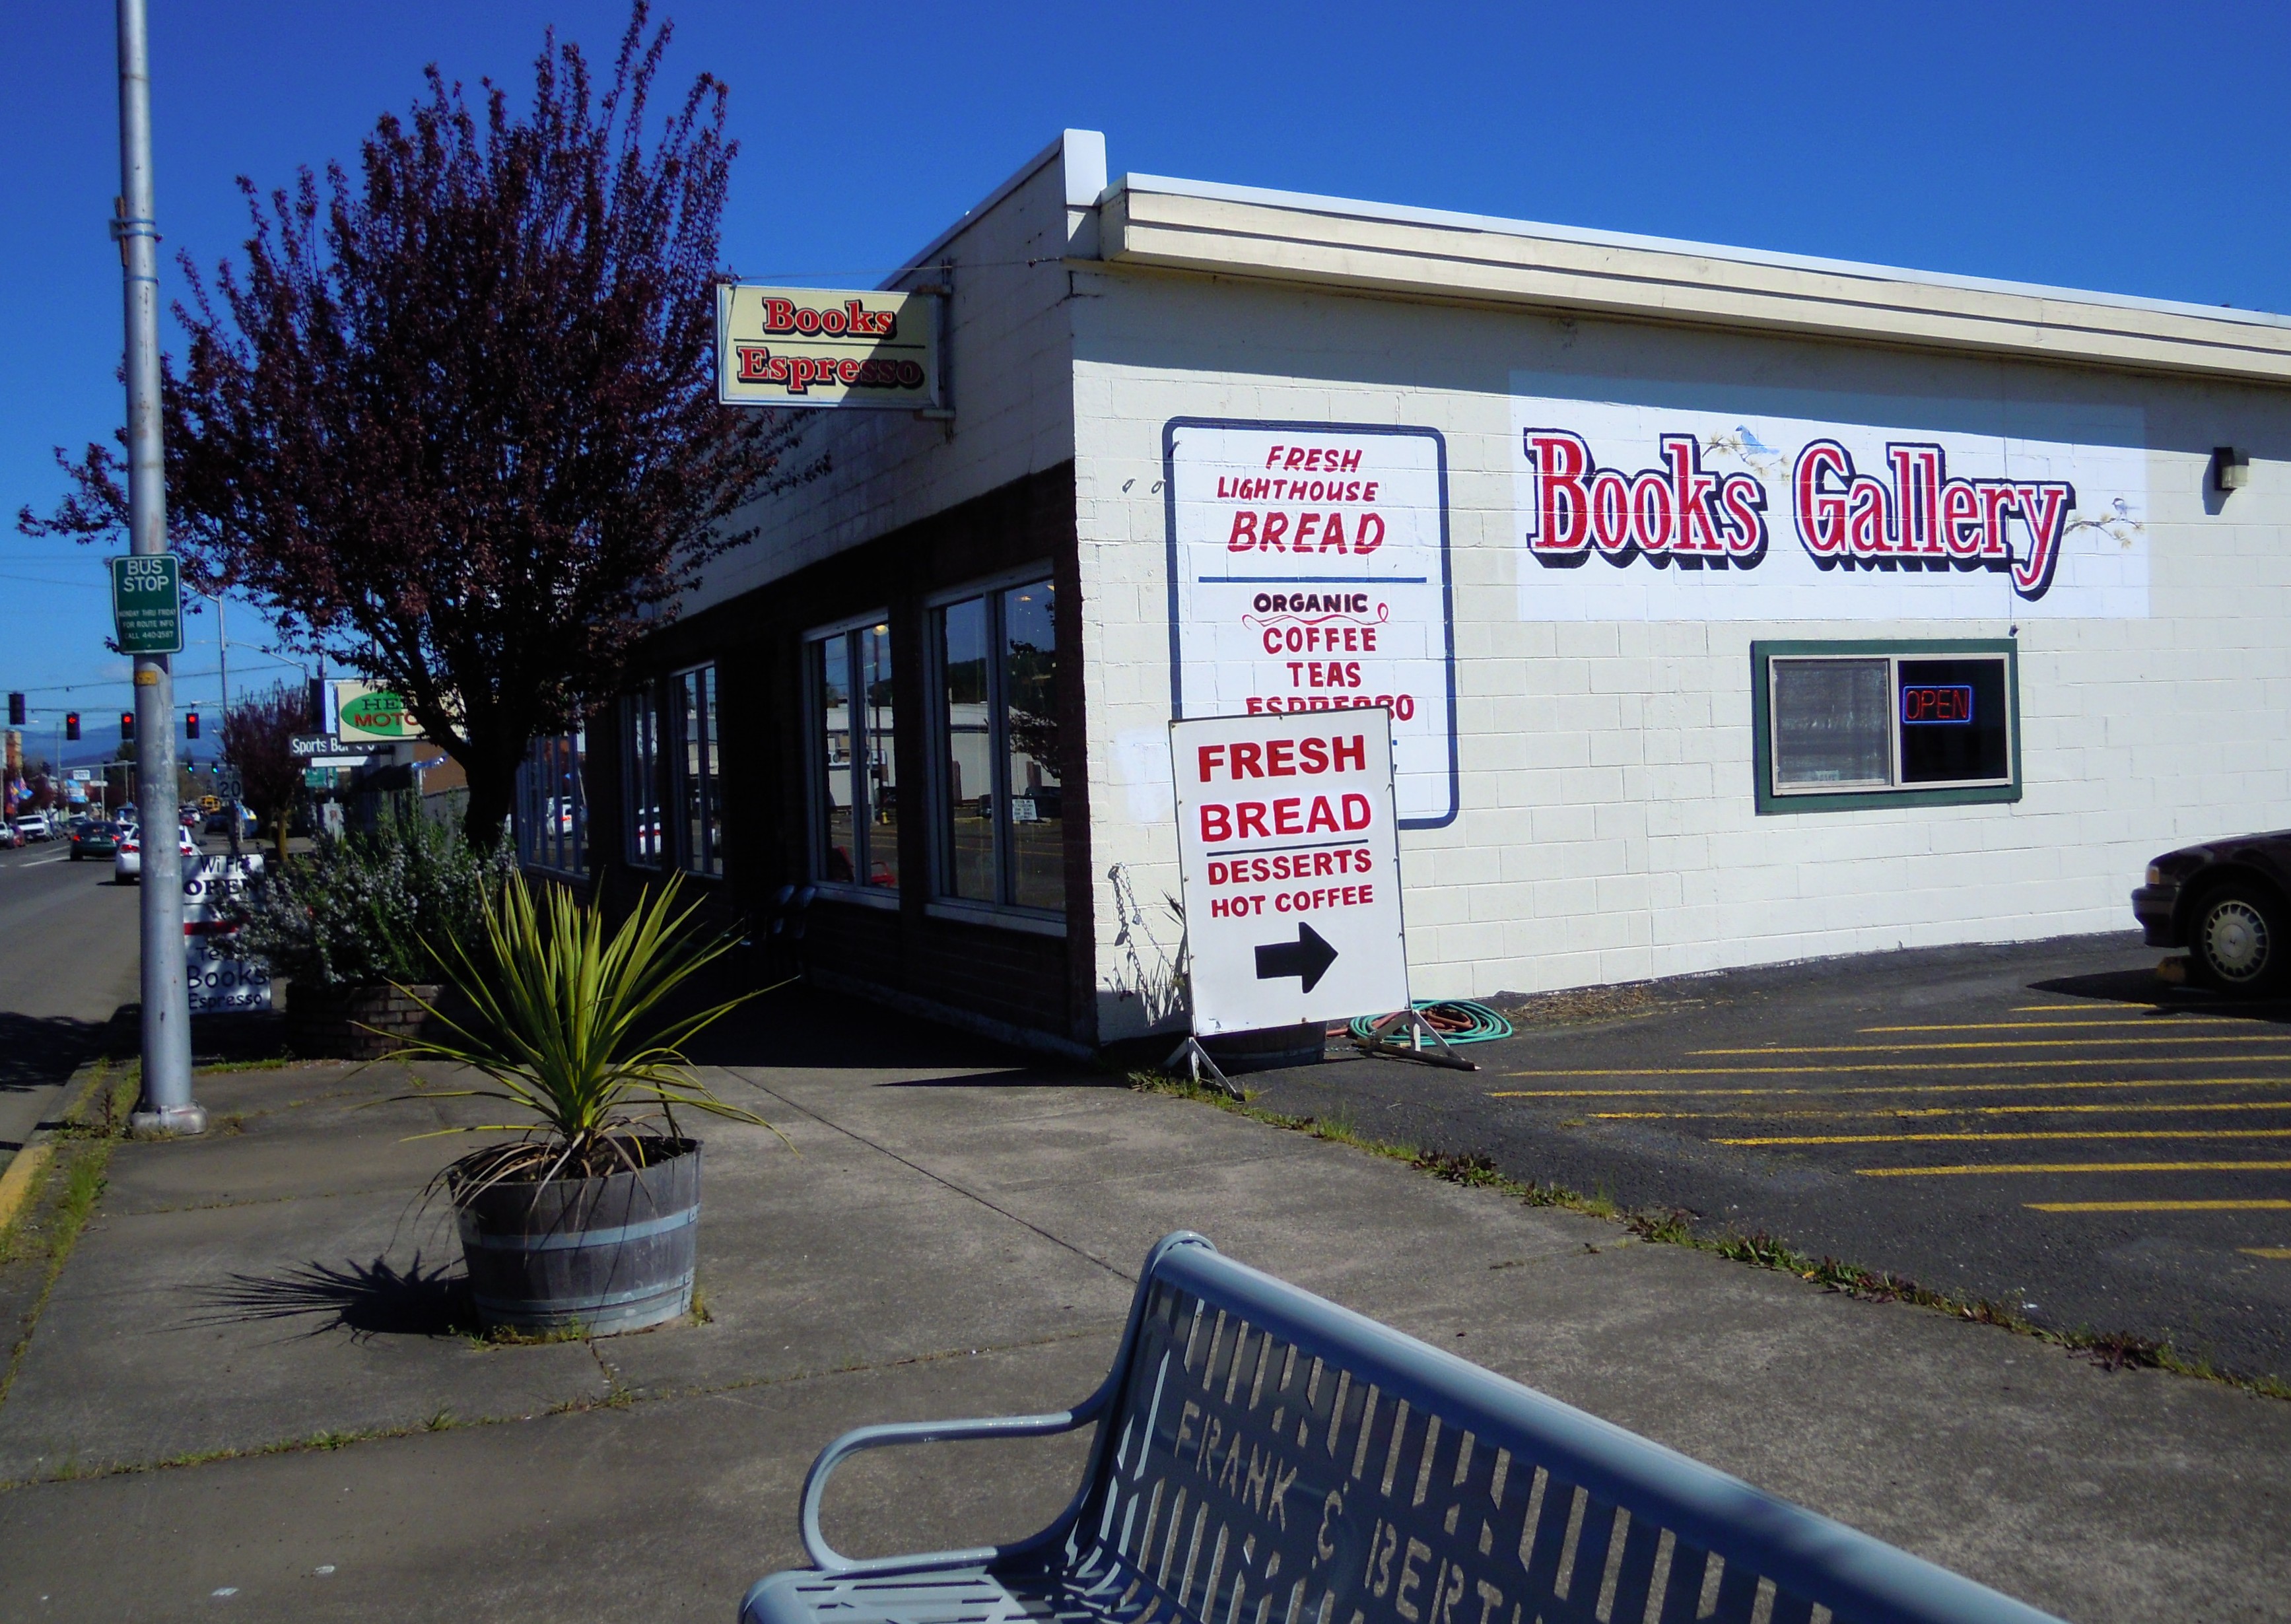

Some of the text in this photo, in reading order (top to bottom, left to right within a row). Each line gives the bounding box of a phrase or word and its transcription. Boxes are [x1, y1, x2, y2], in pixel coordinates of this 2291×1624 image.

[762, 296, 897, 340] Books
[736, 346, 924, 395] Espresso
[1266, 445, 1362, 473] FRESH
[1217, 476, 1379, 502] LIGHTHOUSE
[1523, 427, 2076, 601] Books Gallery
[1227, 511, 1386, 555] BREAD
[127, 560, 162, 575] BUS
[123, 576, 169, 592] STOP
[1254, 593, 1369, 613] ORGANIC
[1263, 627, 1377, 654] COFFEE
[1287, 662, 1361, 688] TEAS
[1906, 689, 1968, 720] OPEN
[292, 738, 327, 755] Sports
[1198, 735, 1366, 782] FRESH
[219, 780, 241, 797] 20
[1200, 794, 1372, 842] BREAD
[201, 856, 221, 873] Wi
[1207, 848, 1372, 885] DESSERTS
[1212, 885, 1373, 918] HOT COFFEE
[187, 961, 266, 989] Books
[189, 993, 263, 1012] Espresso
[1175, 1400, 1297, 1532] FRANK
